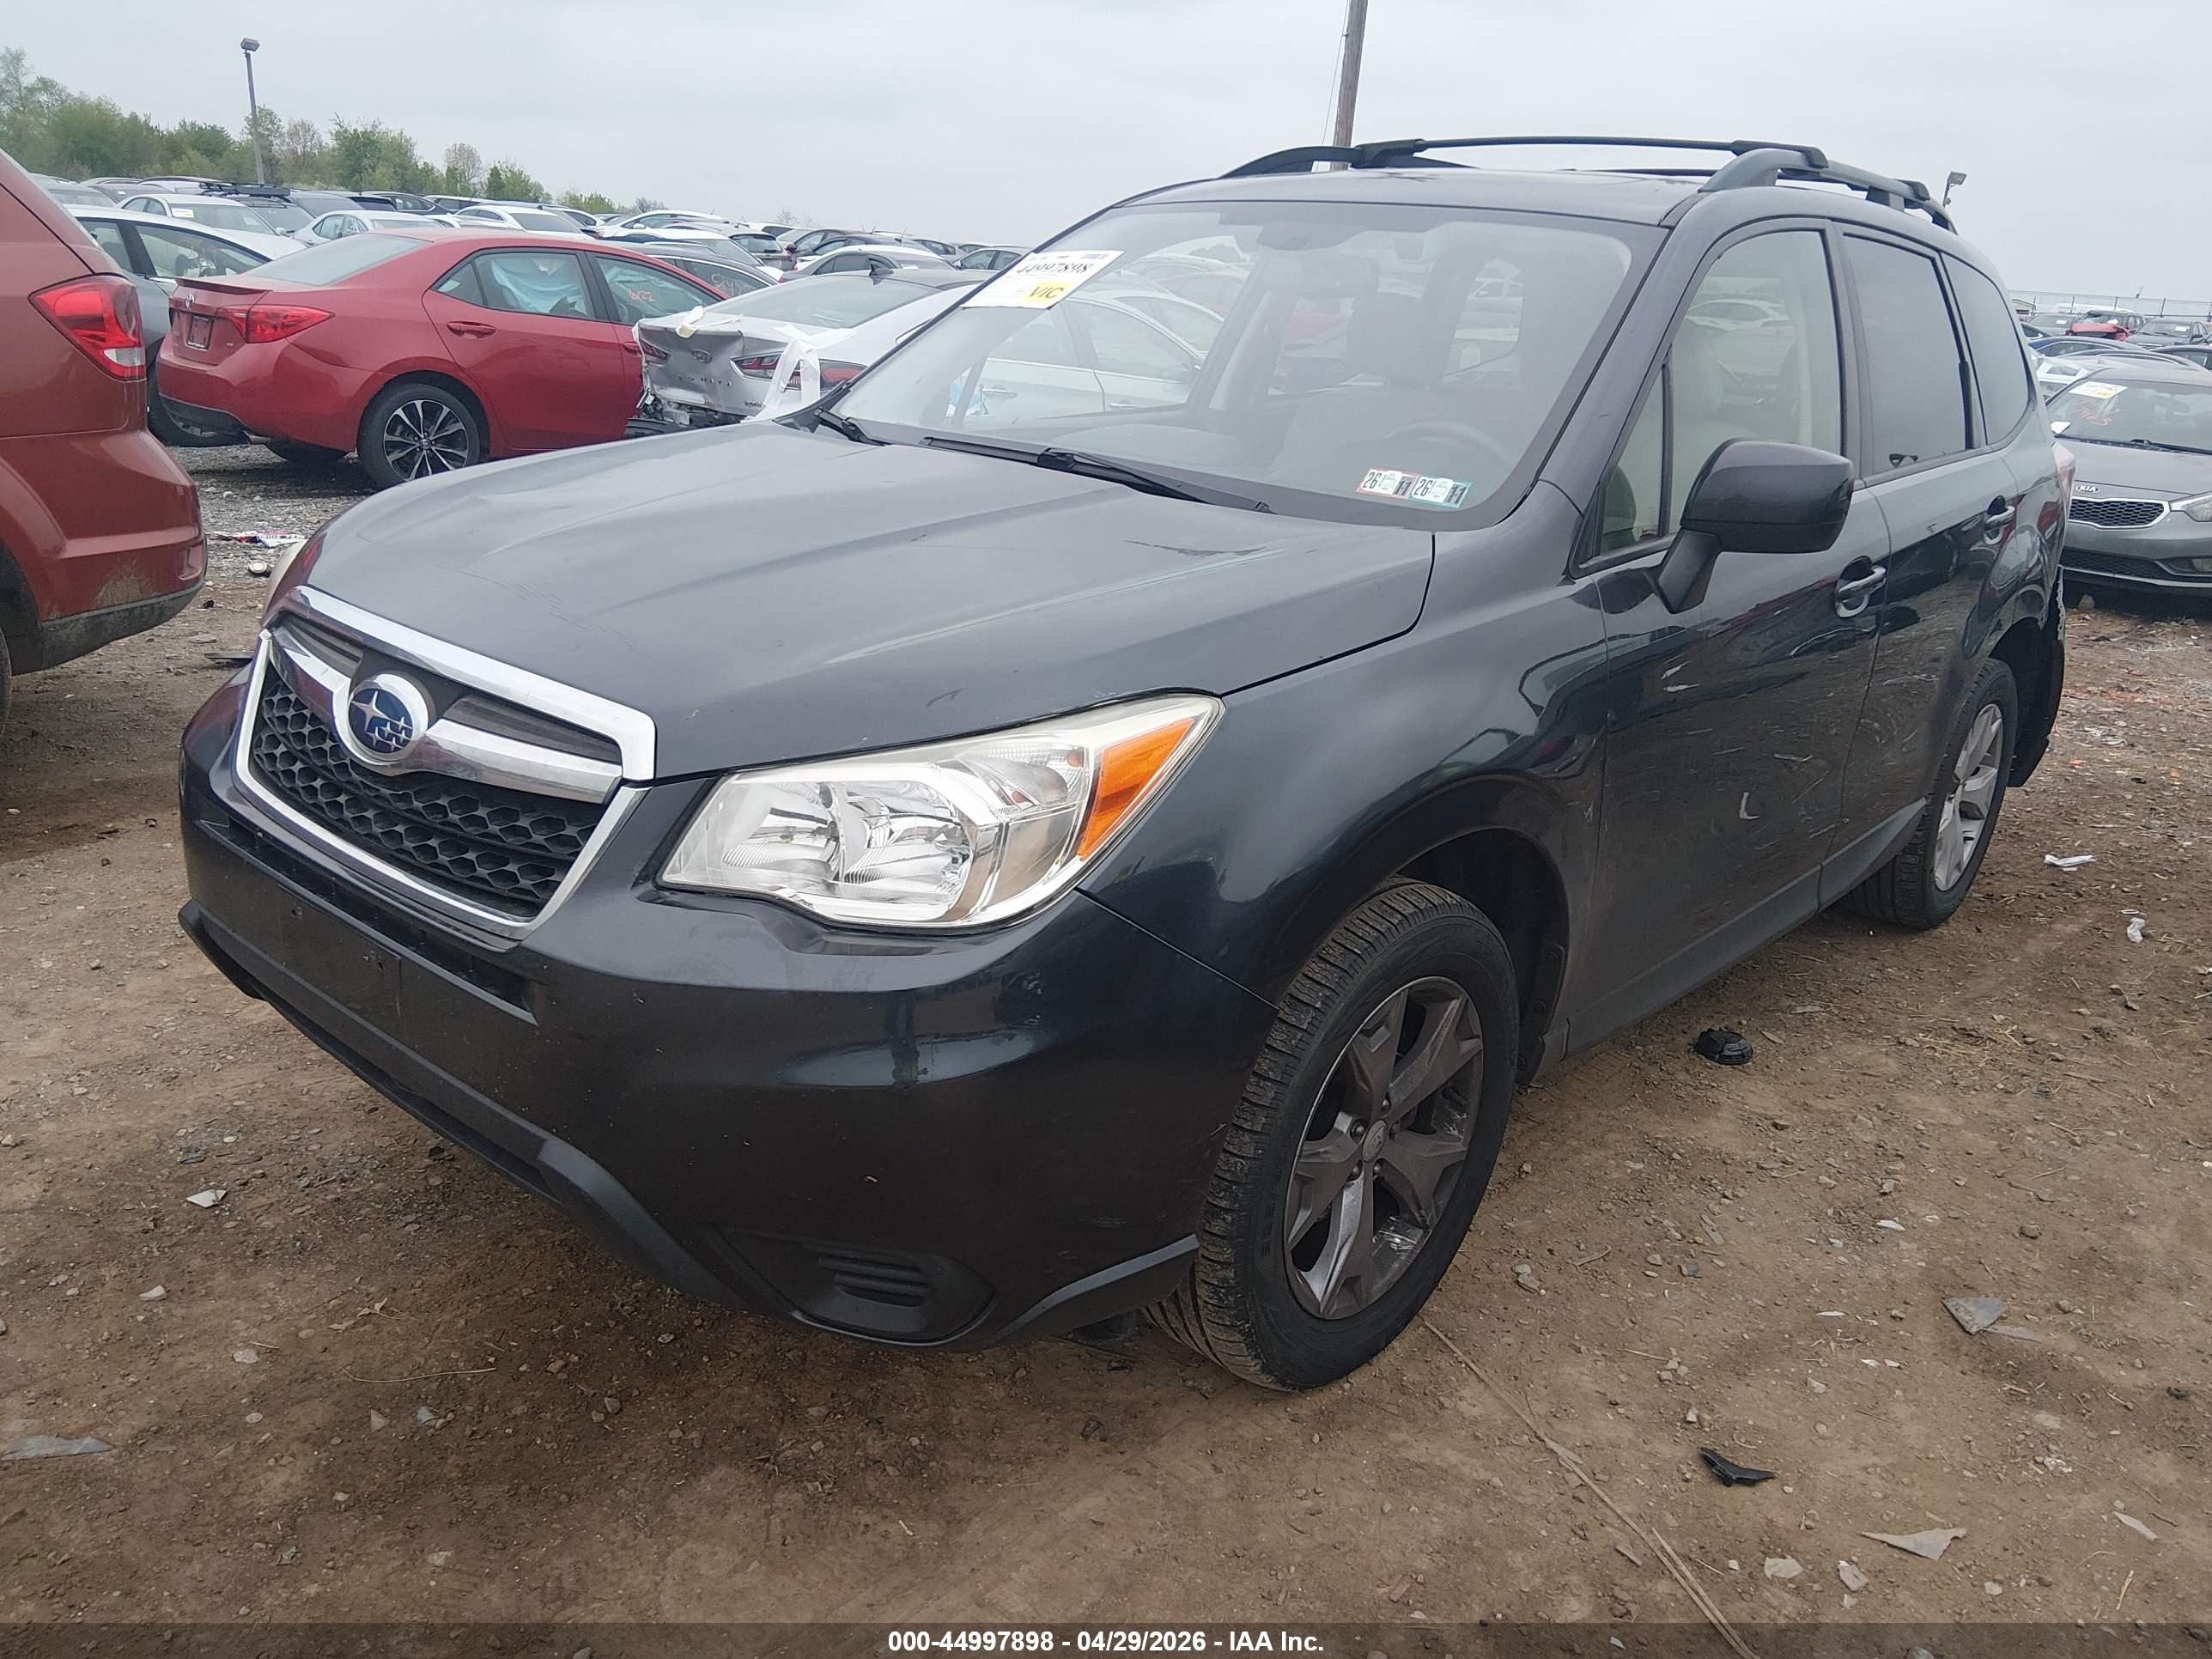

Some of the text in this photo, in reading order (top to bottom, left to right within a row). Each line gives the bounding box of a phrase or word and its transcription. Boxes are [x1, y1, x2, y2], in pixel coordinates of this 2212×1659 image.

[1030, 286, 1065, 299] VIC
[1363, 471, 1382, 489] 26
[1413, 478, 1433, 496] 26
